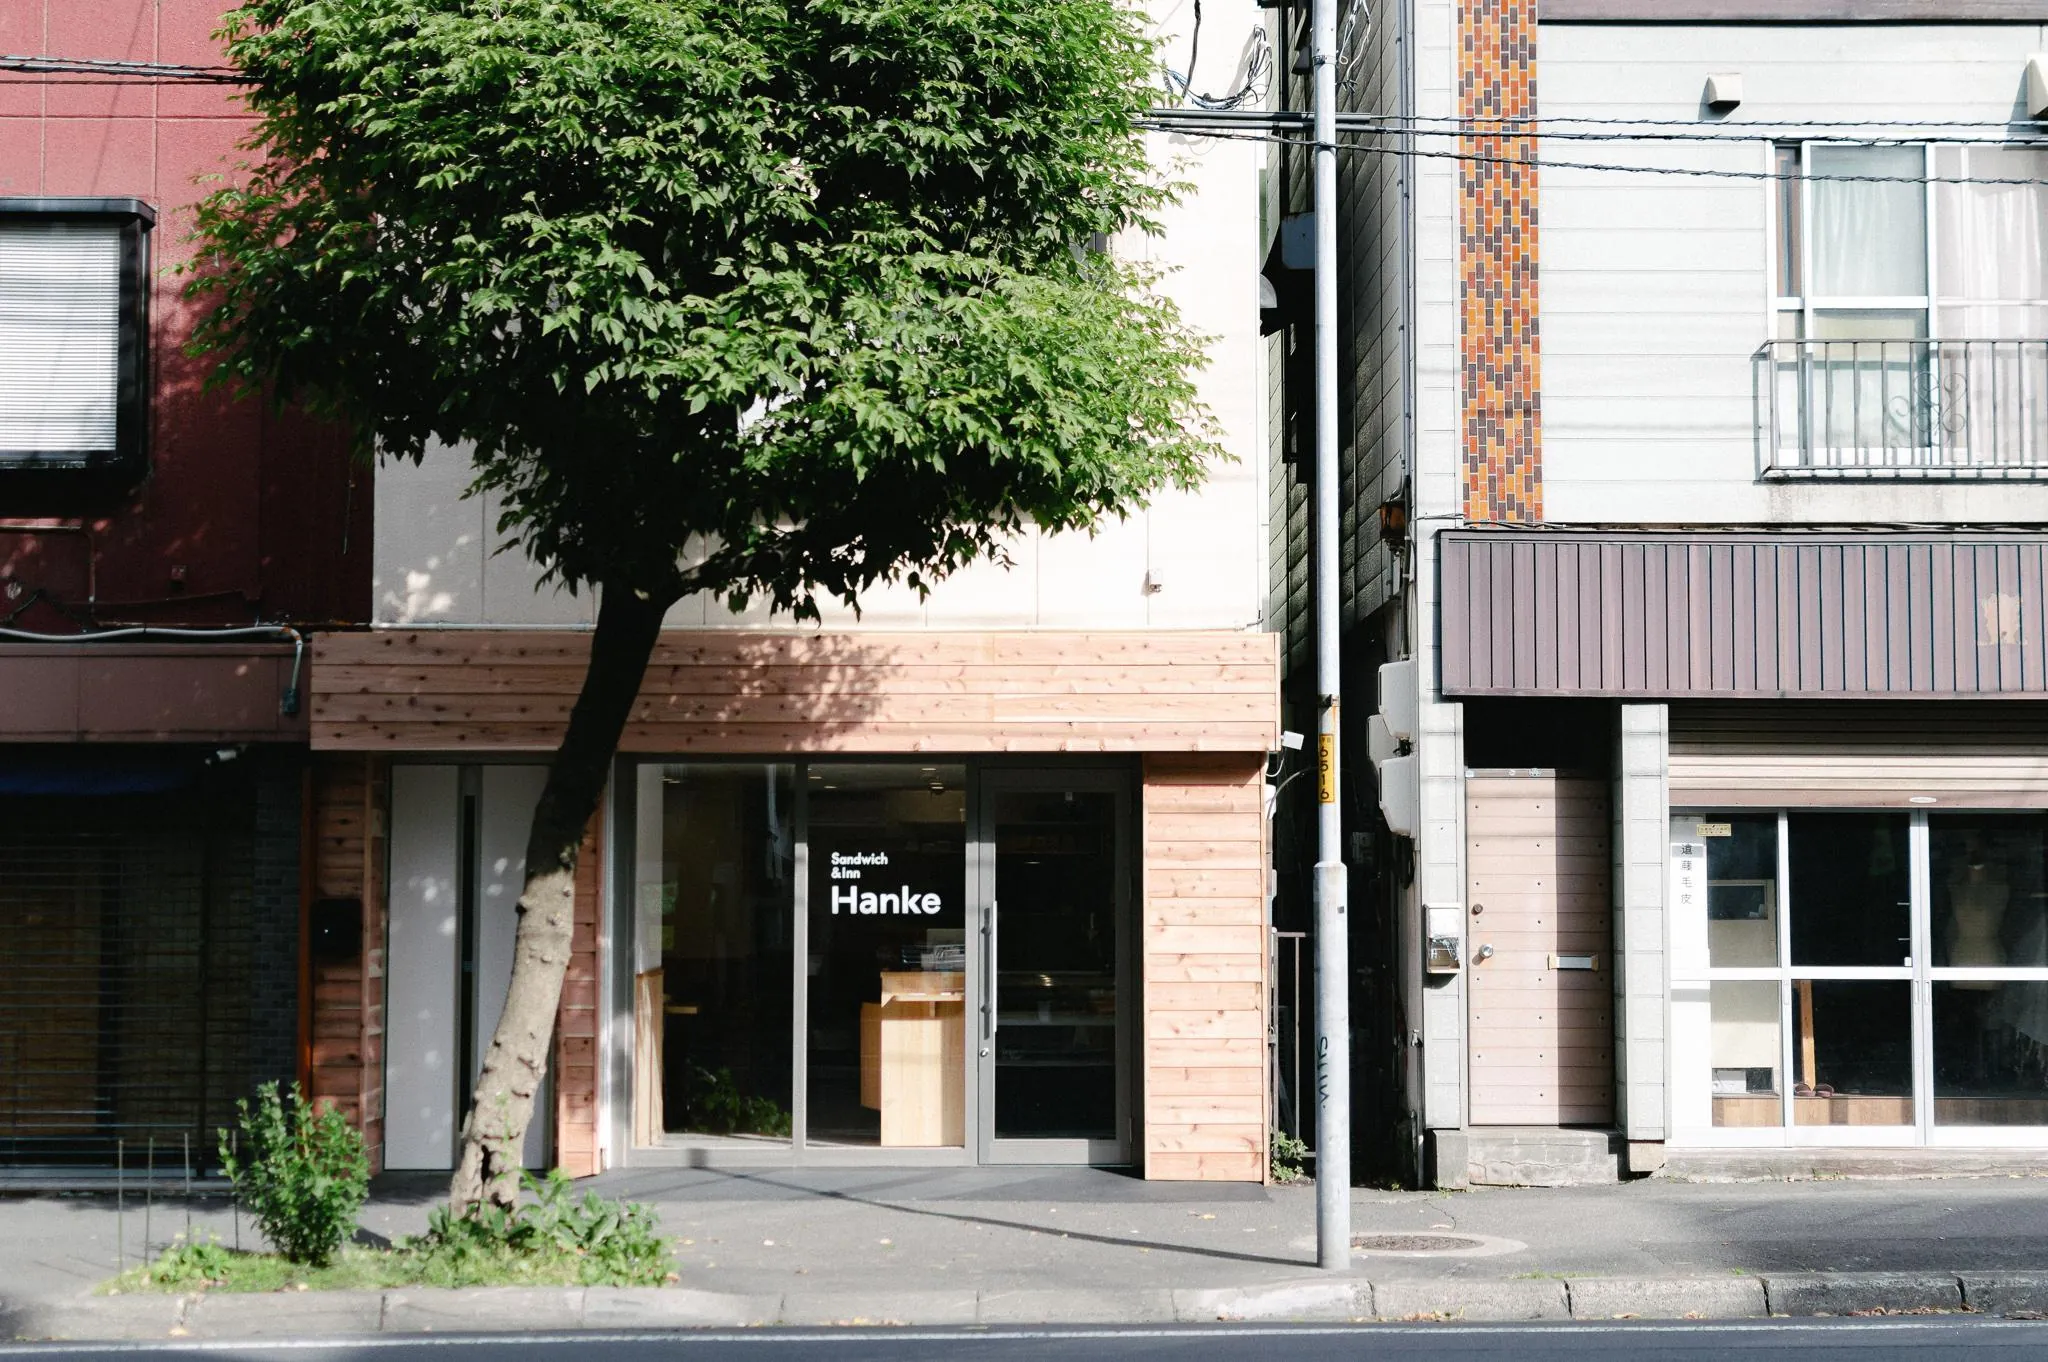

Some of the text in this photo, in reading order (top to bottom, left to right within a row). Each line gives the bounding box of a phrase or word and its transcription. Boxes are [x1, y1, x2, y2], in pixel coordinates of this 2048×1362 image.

[1319, 746, 1330, 800] 6516
[831, 852, 889, 866] Sandwich
[831, 867, 861, 879] &Inn
[831, 885, 942, 915] Hanke
